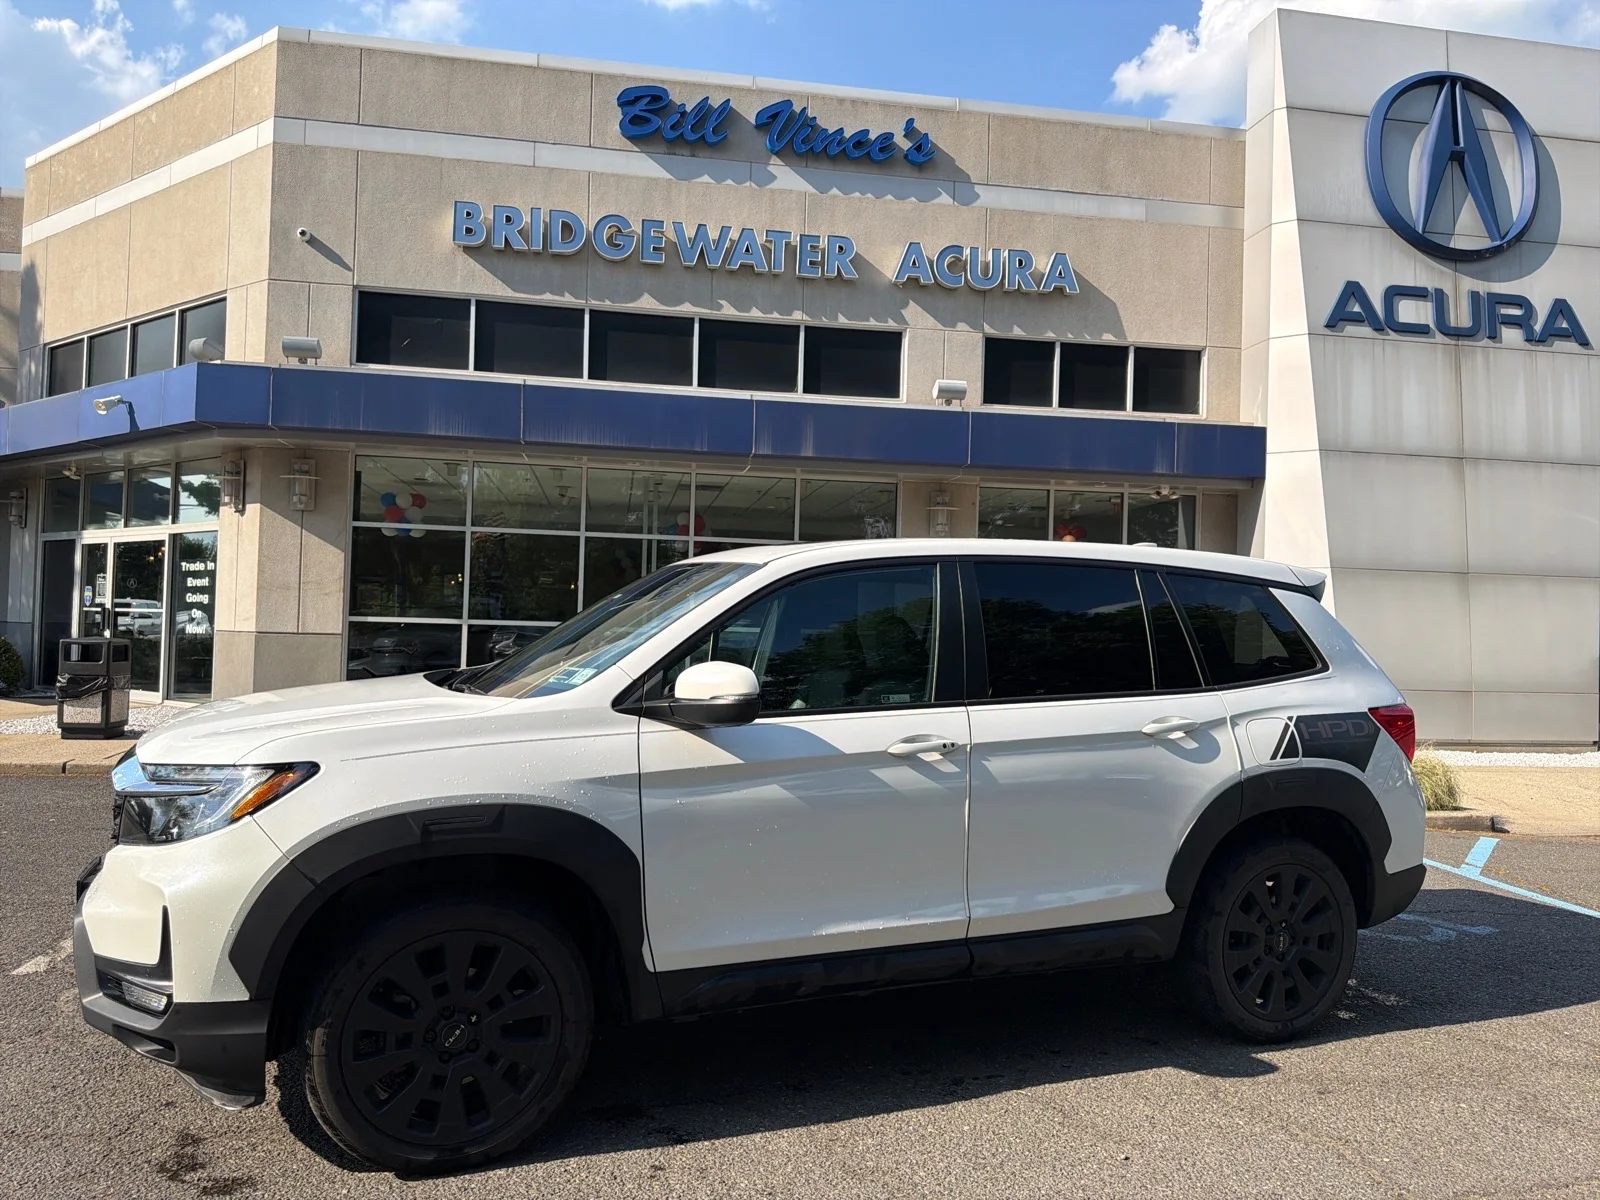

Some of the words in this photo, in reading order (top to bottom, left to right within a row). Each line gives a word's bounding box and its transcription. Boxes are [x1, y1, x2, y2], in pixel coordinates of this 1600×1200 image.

[616, 85, 731, 146] Bill
[755, 98, 935, 166] Vince's
[452, 200, 858, 281] BRIDGEWATER
[893, 241, 1080, 296] ACURA
[1324, 280, 1590, 347] ACURA
[181, 561, 205, 571] Trade
[187, 577, 209, 587] Event
[186, 592, 209, 604] Going
[191, 608, 202, 618] On
[185, 624, 206, 634] Now!
[1299, 719, 1375, 740] HPD
